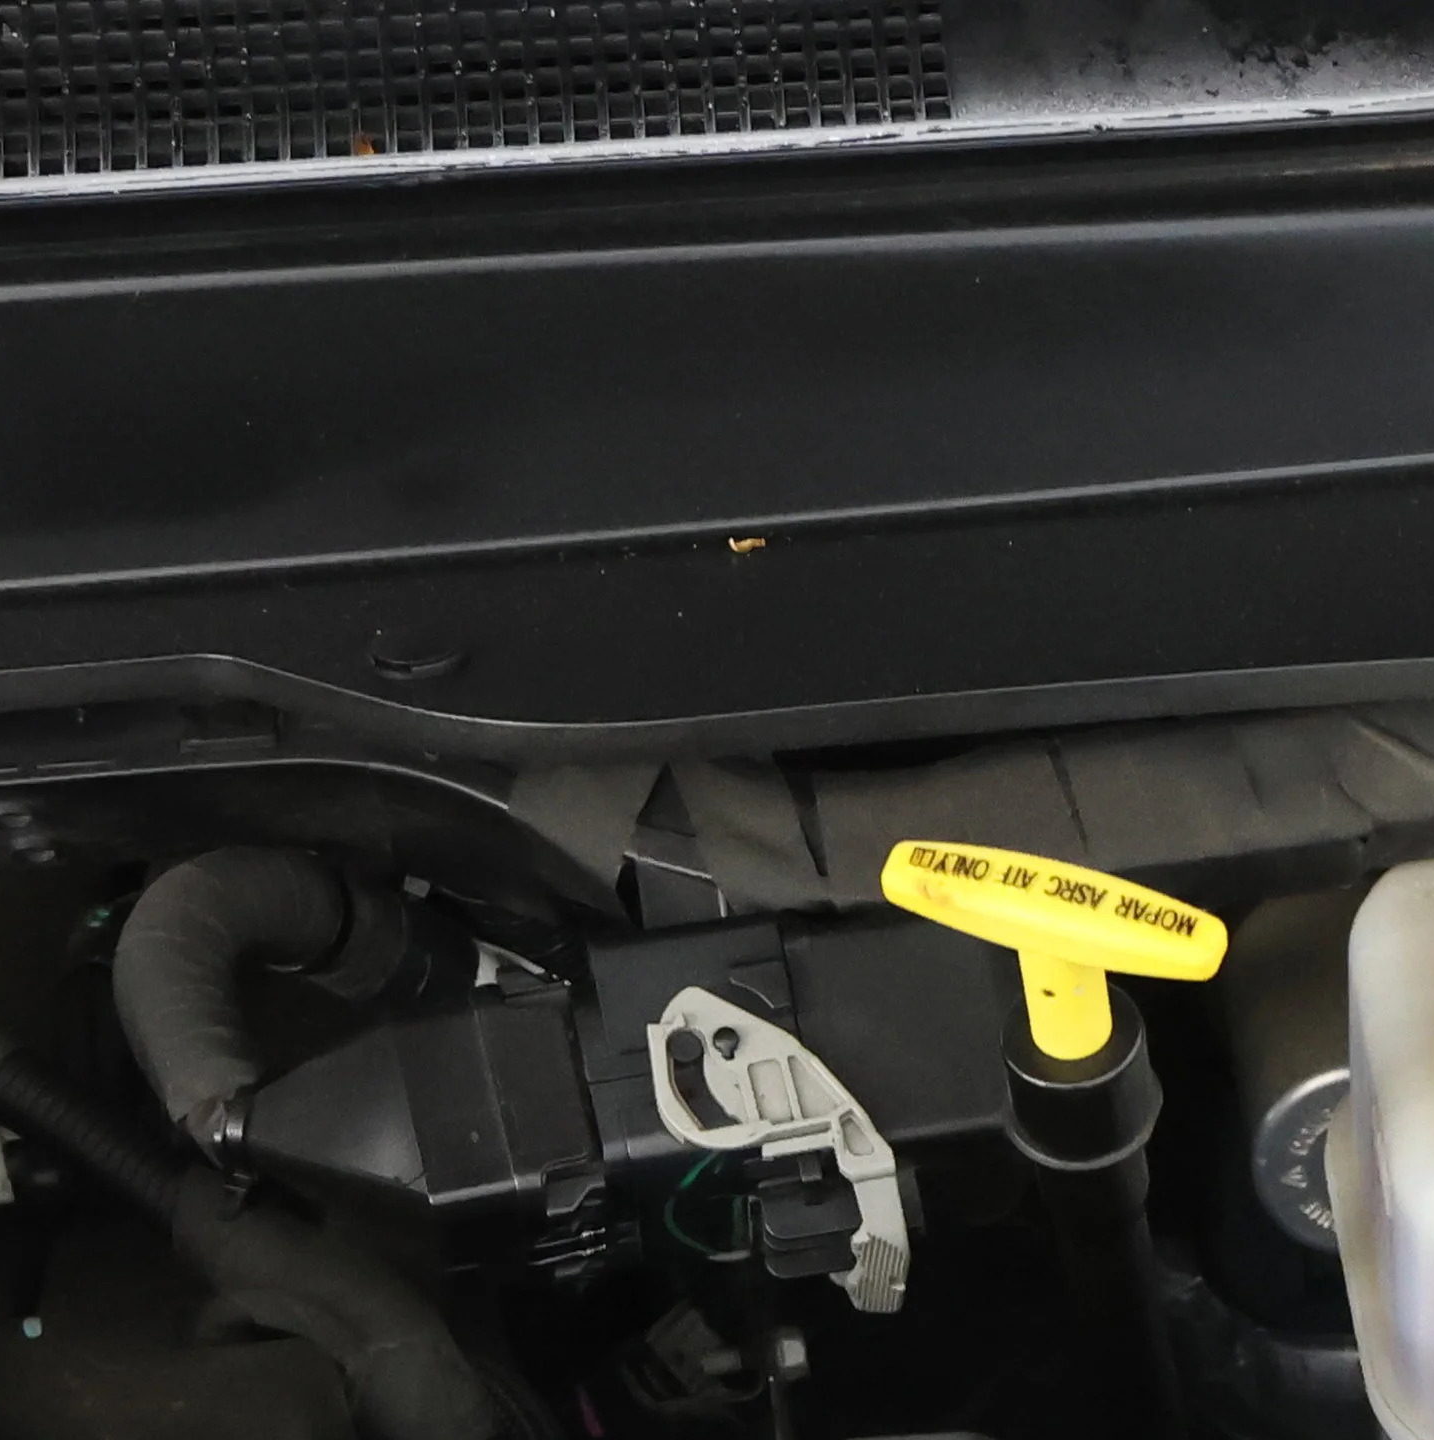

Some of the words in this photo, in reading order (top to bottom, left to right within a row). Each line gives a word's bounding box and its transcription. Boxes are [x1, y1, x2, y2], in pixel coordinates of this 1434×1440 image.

[932, 853, 990, 881] ONLY
[1002, 865, 1038, 891] ATF
[1044, 876, 1108, 911] ASRC
[1115, 895, 1198, 938] MOPAR
